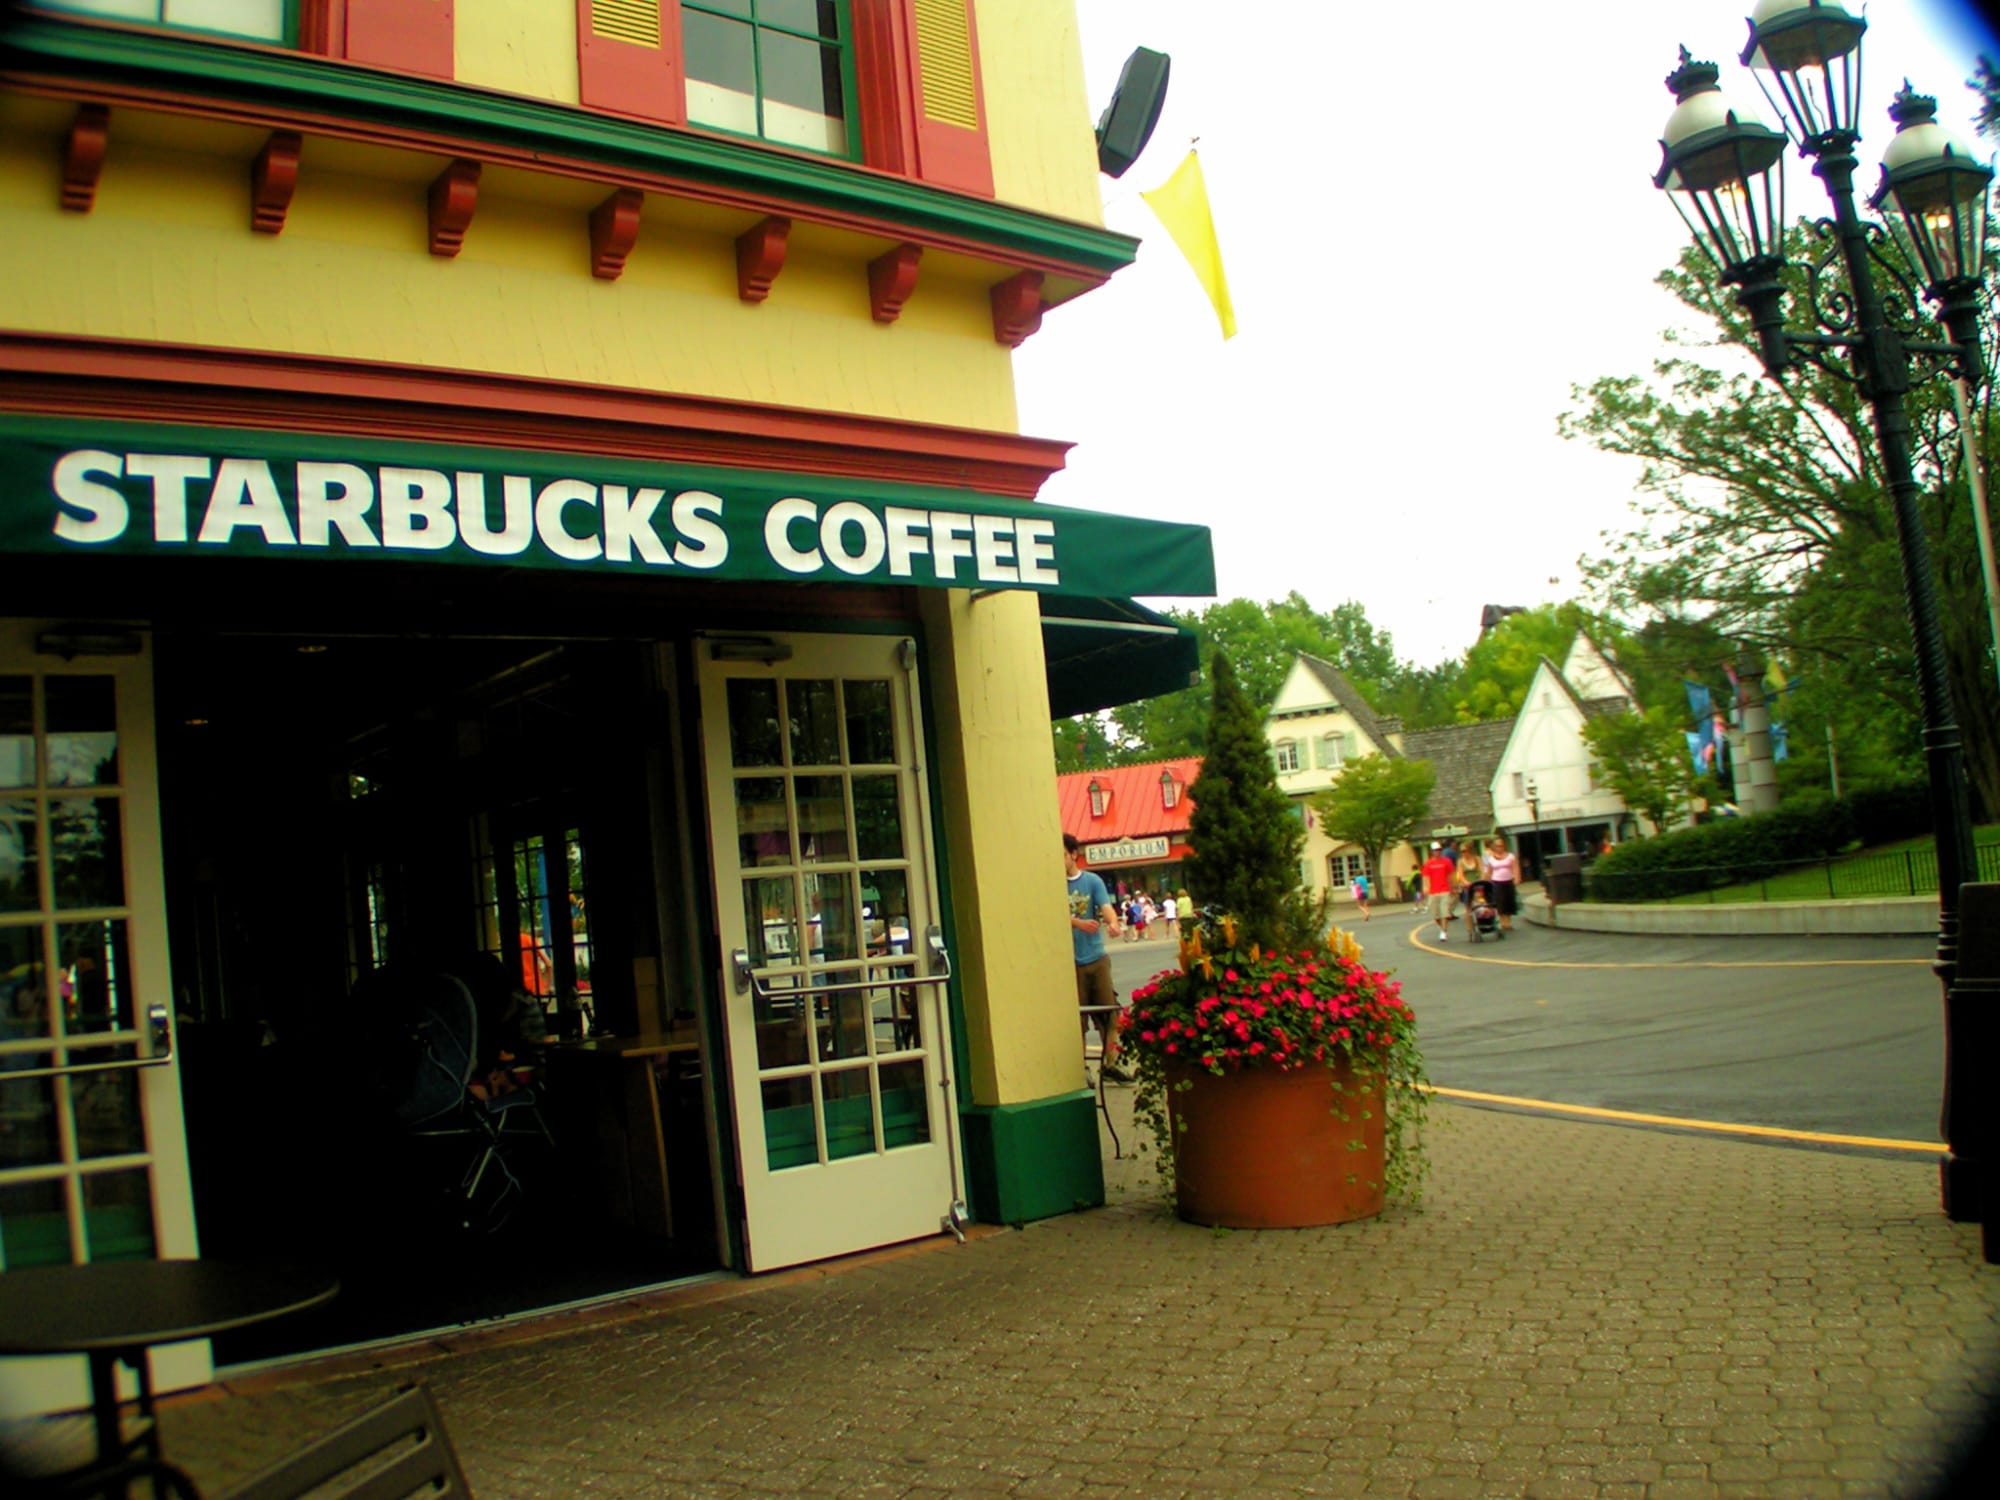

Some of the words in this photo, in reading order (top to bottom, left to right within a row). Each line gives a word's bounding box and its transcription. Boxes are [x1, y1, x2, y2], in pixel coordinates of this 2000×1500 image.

[52, 449, 729, 570] STARBUCKS
[764, 497, 1060, 585] COFFEE
[1088, 839, 1166, 860] EMPORIUM
